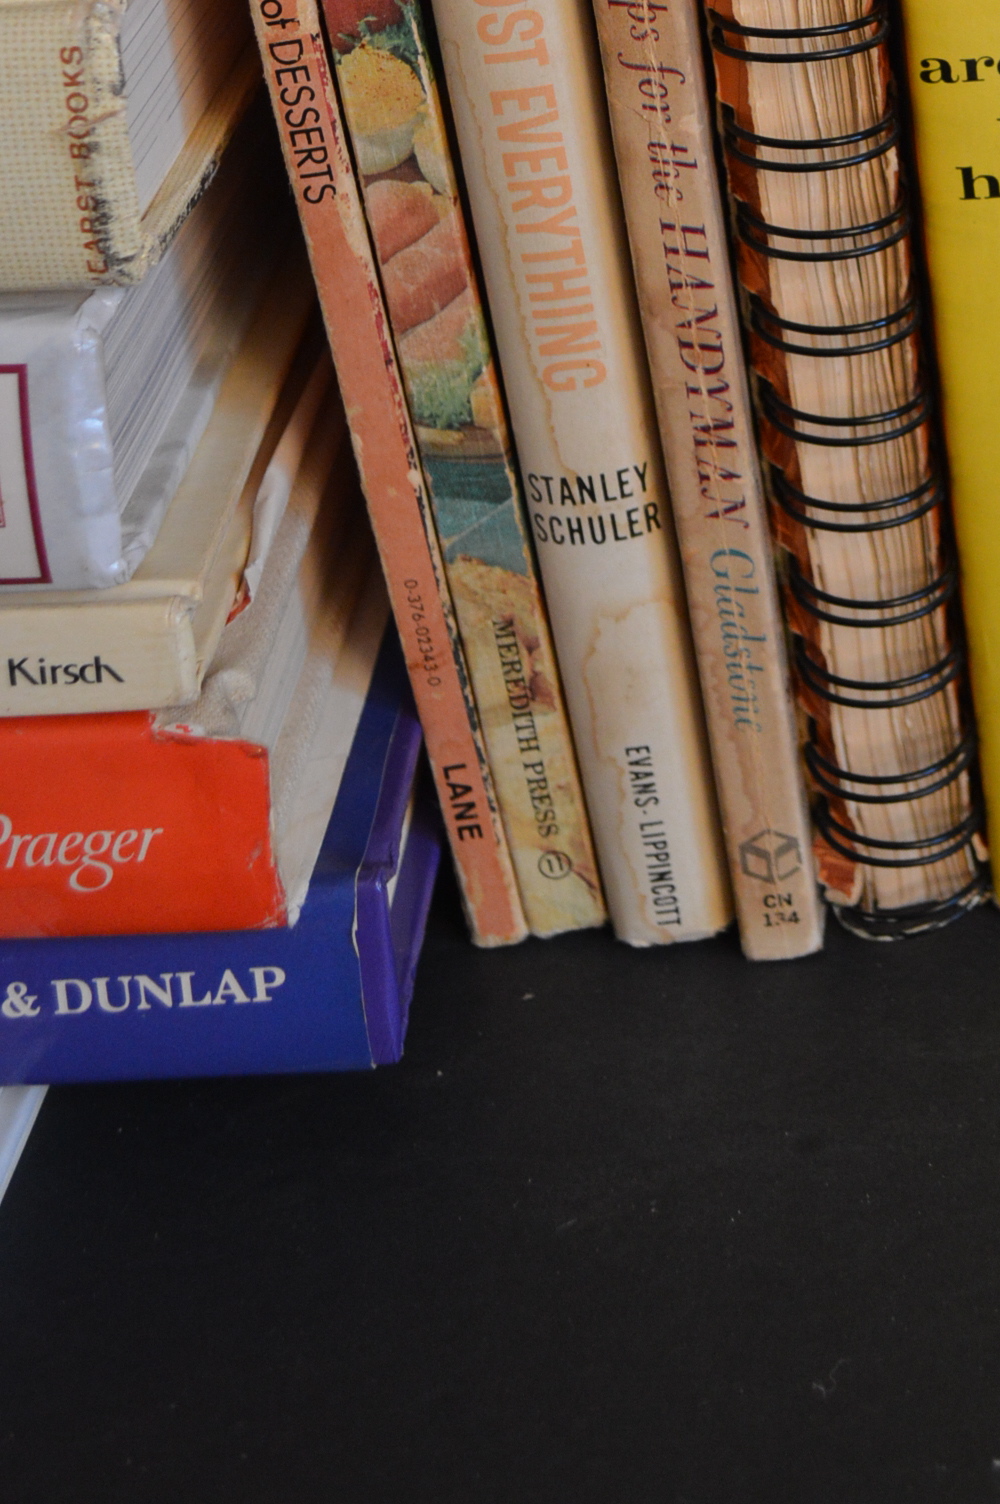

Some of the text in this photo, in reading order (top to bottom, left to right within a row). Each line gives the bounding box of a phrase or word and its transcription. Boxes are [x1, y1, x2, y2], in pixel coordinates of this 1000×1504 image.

[269, 38, 336, 206] DESSERTS
[617, 51, 686, 124] for
[646, 139, 698, 203] the
[74, 175, 113, 286] EARST
[489, 83, 607, 393] EVERYTHING
[659, 217, 750, 530] HANDYMAN
[527, 461, 648, 506] STANLEY
[533, 502, 662, 546] SCHULER
[7, 655, 125, 686] Kirsch
[492, 619, 559, 838] MEREDITH PRESS
[442, 763, 482, 841] LANE
[640, 821, 682, 927] LIPPINCOTT
[763, 893, 793, 909] CN
[1, 966, 286, 1019] & DUNLAP
